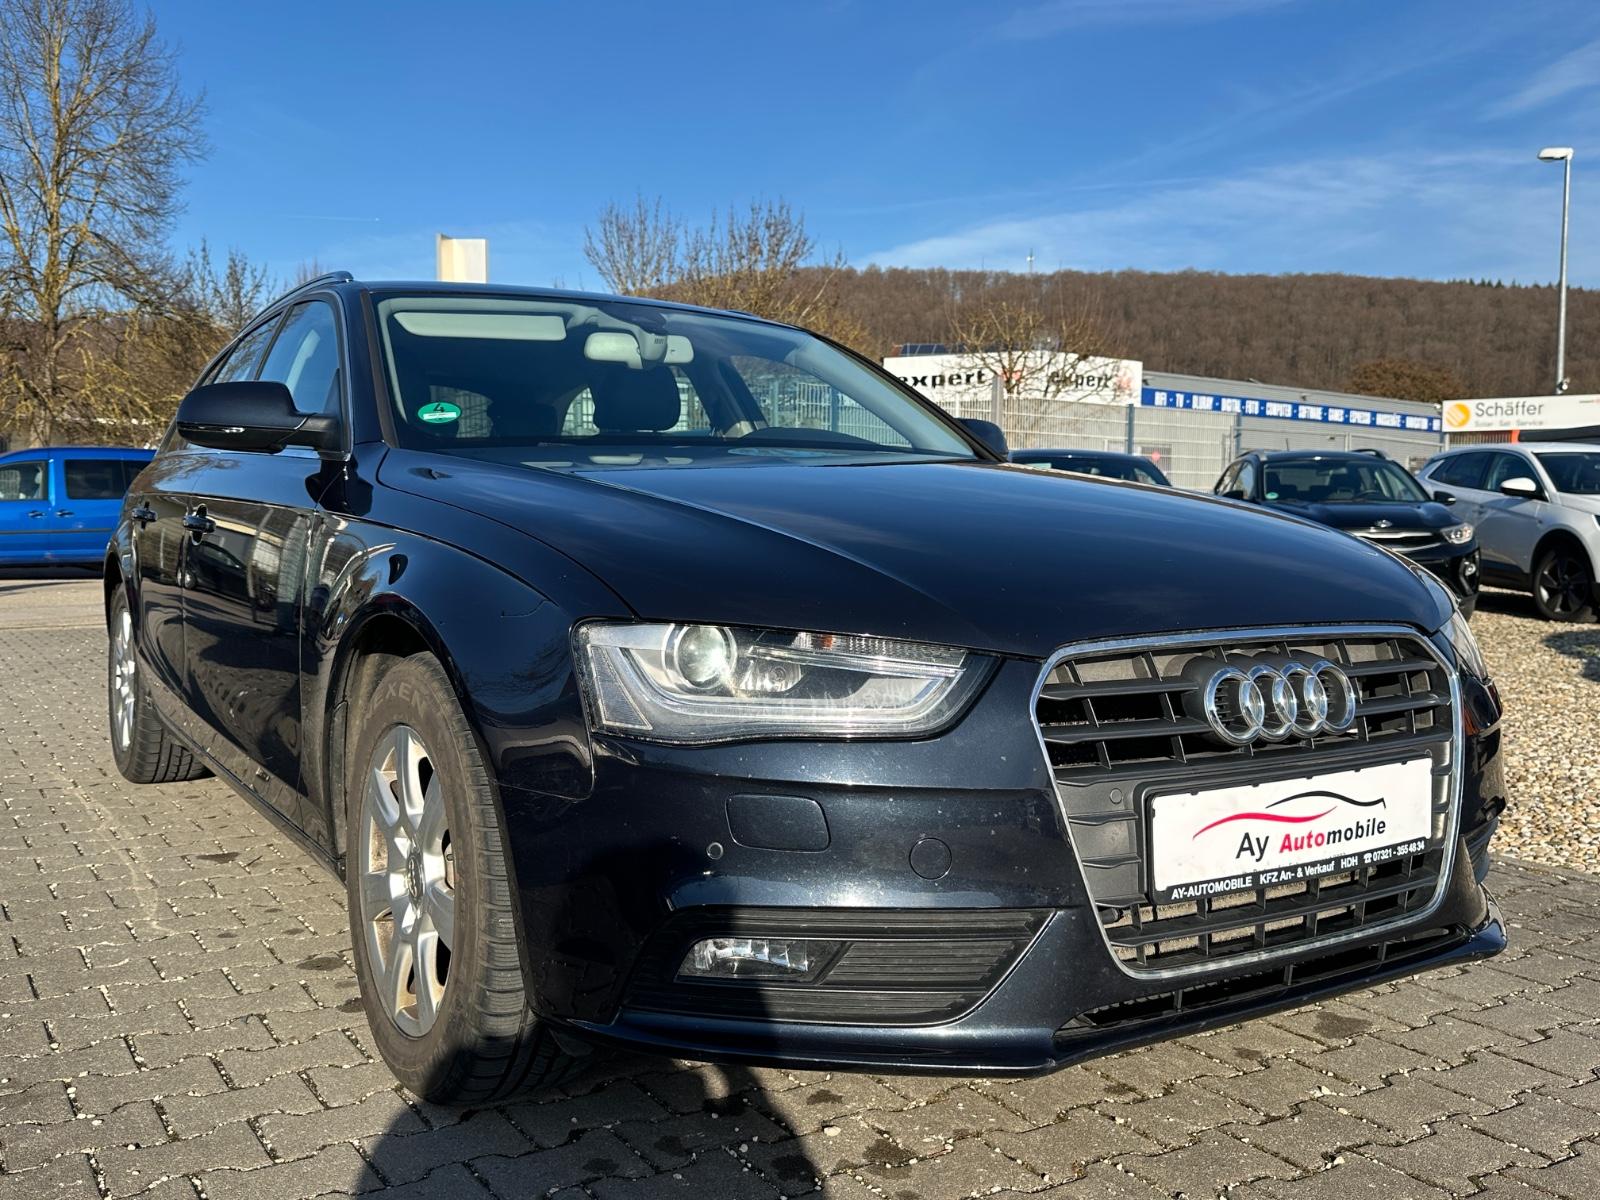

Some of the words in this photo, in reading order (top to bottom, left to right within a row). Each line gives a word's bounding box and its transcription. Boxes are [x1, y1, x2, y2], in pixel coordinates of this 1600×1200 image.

[433, 403, 445, 413] 4
[1475, 401, 1544, 417] Schäffer
[1235, 831, 1270, 863] Ay
[1279, 817, 1386, 854] Automobile
[1171, 875, 1253, 900] AY-AUTOMOBILE
[1259, 871, 1279, 885] KFZ
[1279, 870, 1295, 881] An-
[1296, 868, 1304, 878] &
[1304, 860, 1335, 876] Verkauf
[1340, 855, 1359, 869] HDH
